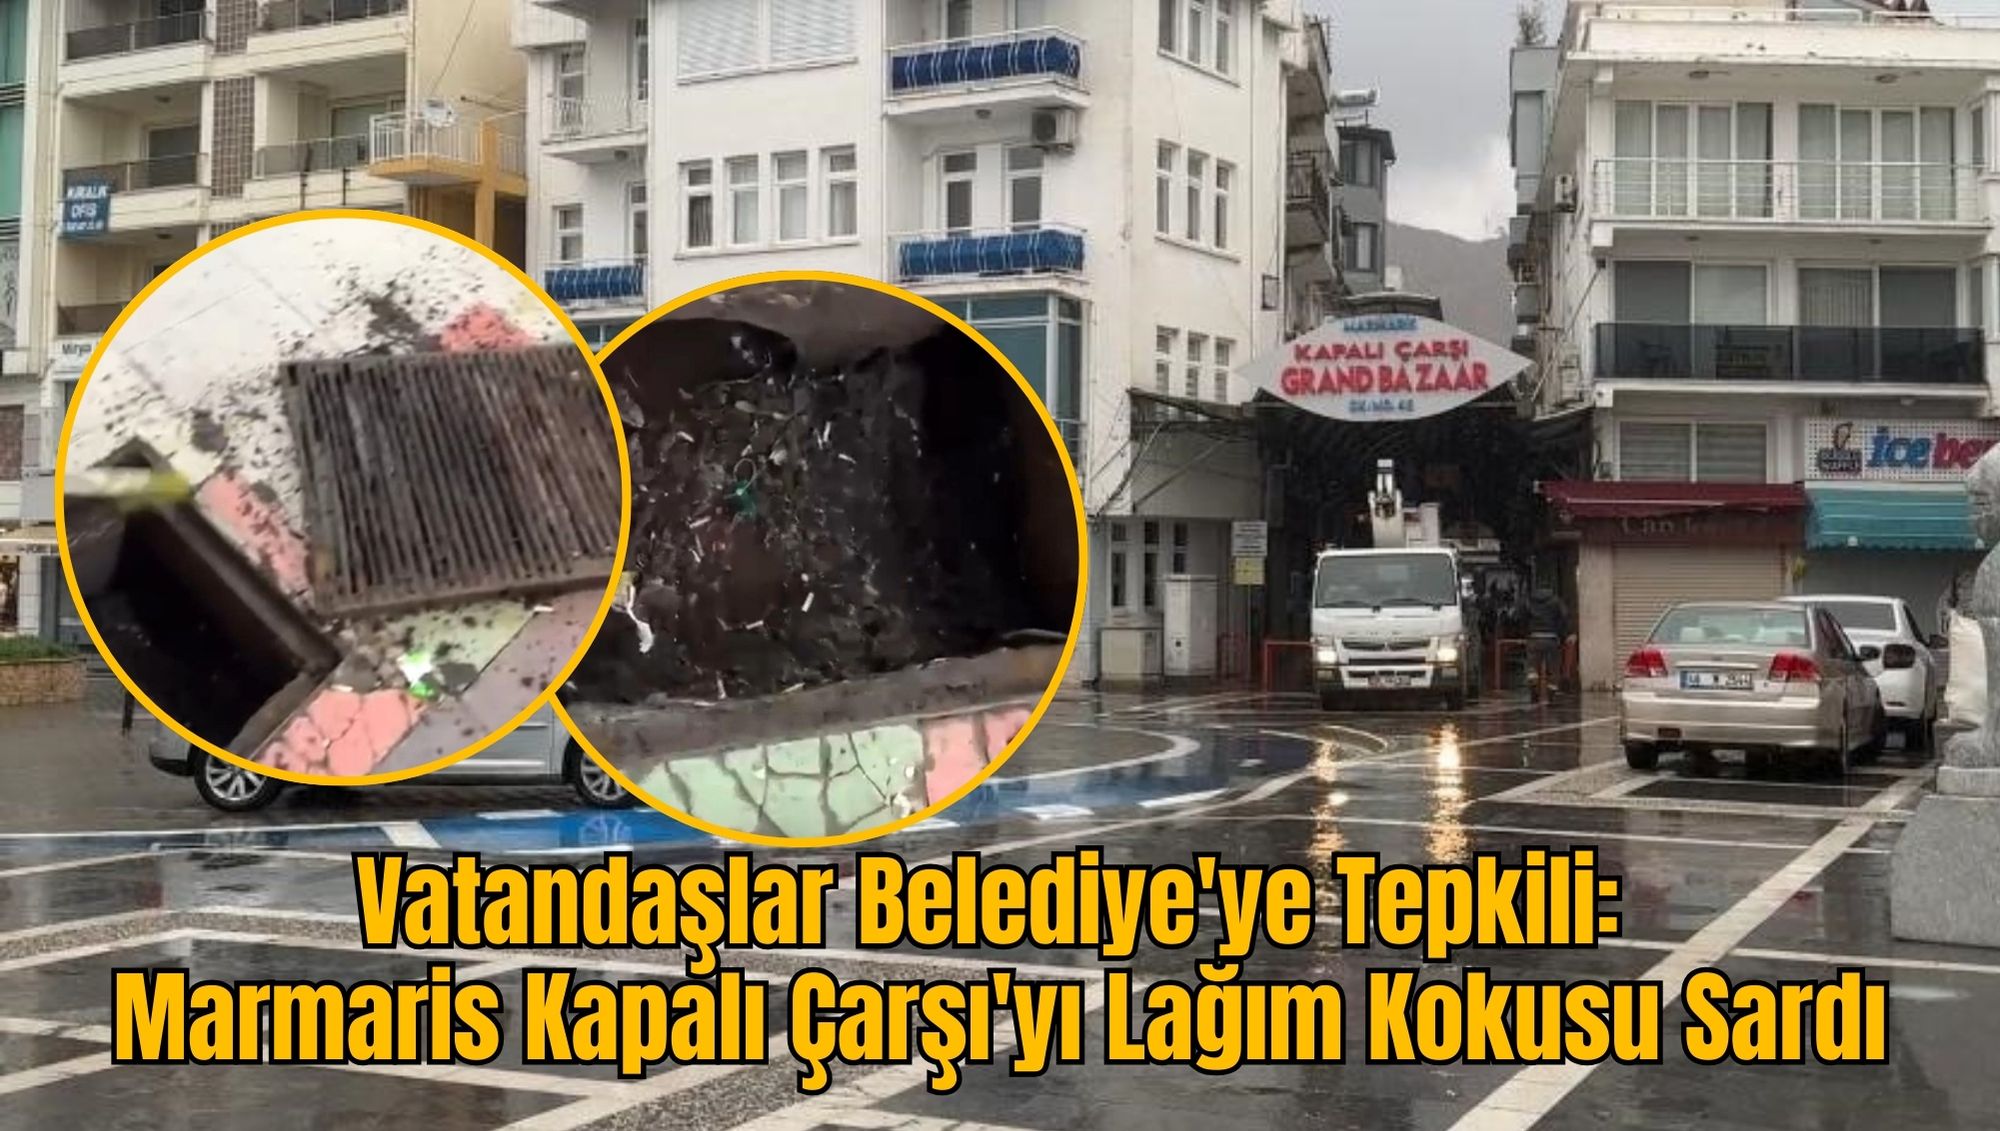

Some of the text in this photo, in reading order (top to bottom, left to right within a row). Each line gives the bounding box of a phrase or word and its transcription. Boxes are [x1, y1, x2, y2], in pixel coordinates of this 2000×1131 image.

[1294, 339, 1470, 363] KAPALI ÇARŞI
[1280, 361, 1489, 397] GRAND BAZAAR
